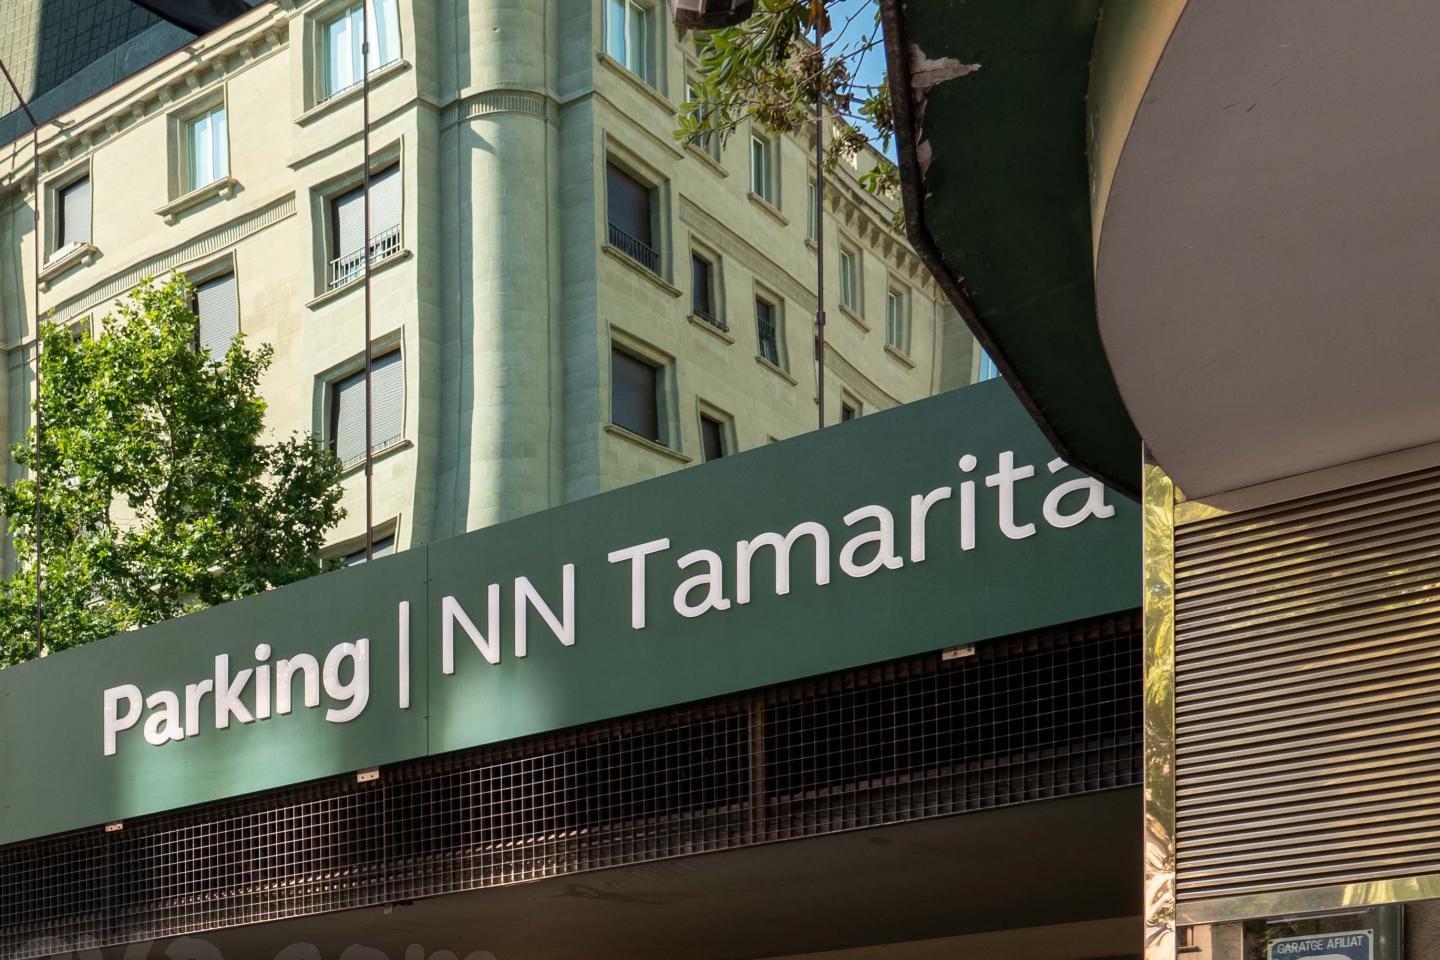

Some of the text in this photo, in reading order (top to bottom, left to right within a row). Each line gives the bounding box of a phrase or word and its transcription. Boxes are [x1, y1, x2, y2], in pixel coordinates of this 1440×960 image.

[104, 638, 370, 756] Parking
[442, 563, 576, 675] NN
[607, 450, 1116, 630] Tamarita
[1277, 936, 1364, 954] GARATGE AFILIAT
